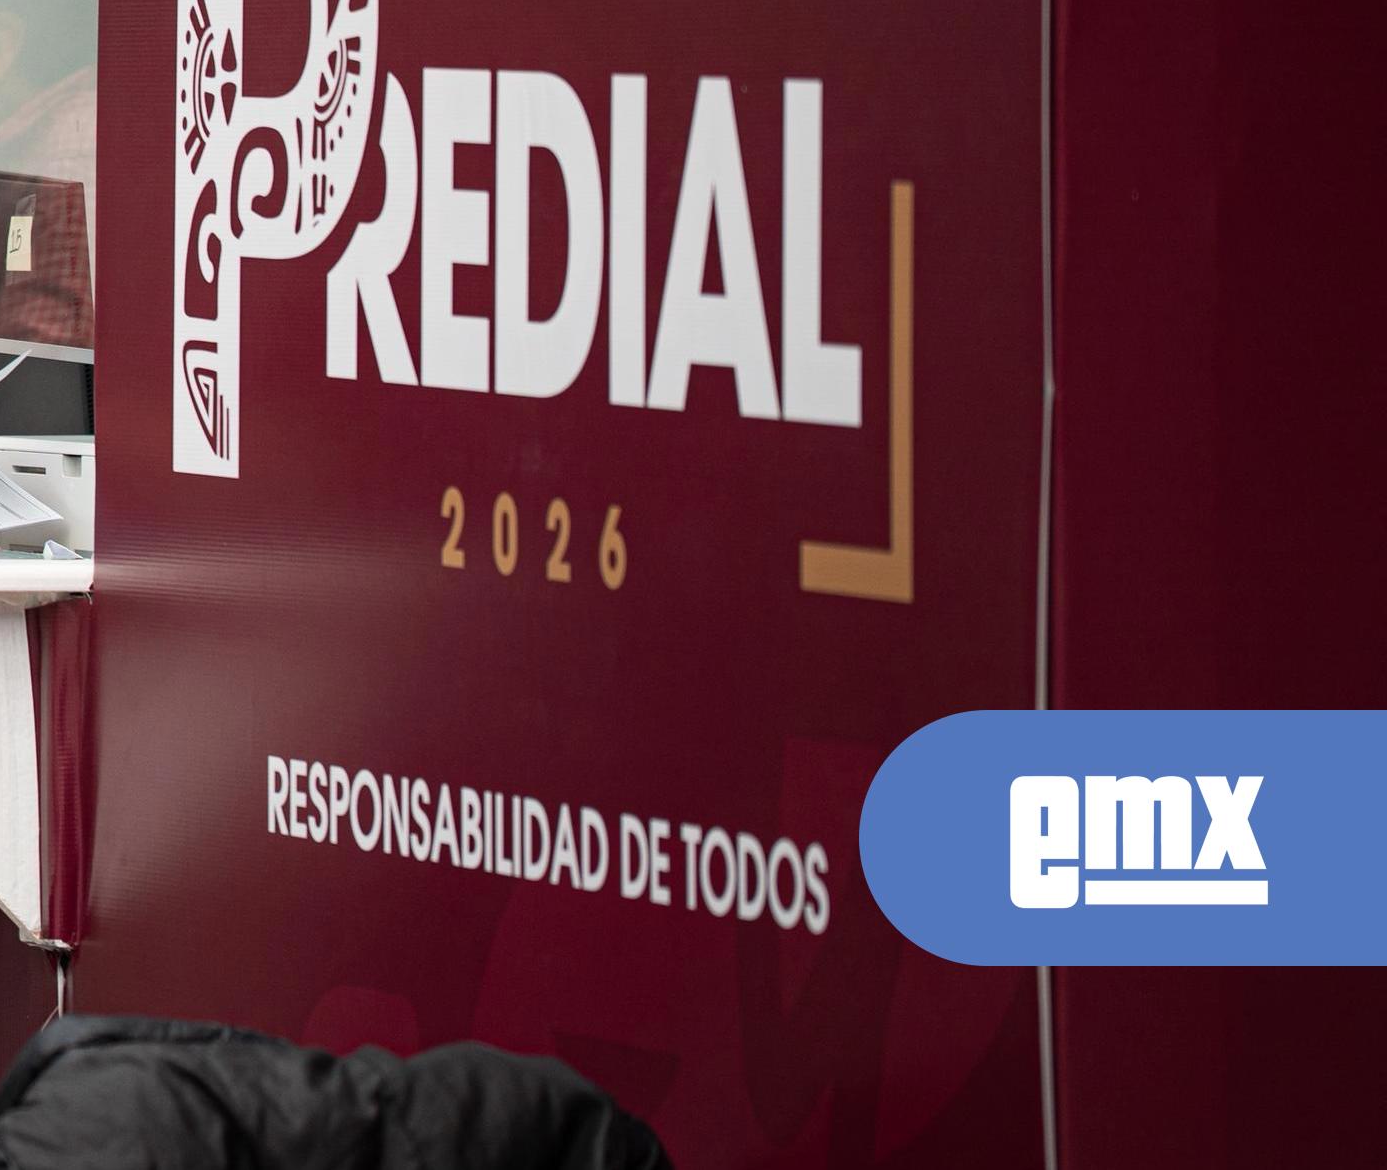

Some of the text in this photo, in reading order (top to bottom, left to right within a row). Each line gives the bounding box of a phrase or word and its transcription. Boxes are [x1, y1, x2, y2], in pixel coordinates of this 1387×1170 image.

[440, 486, 627, 591] 2026
[267, 754, 829, 936] RESPONSABILIDAD DE TODOS
